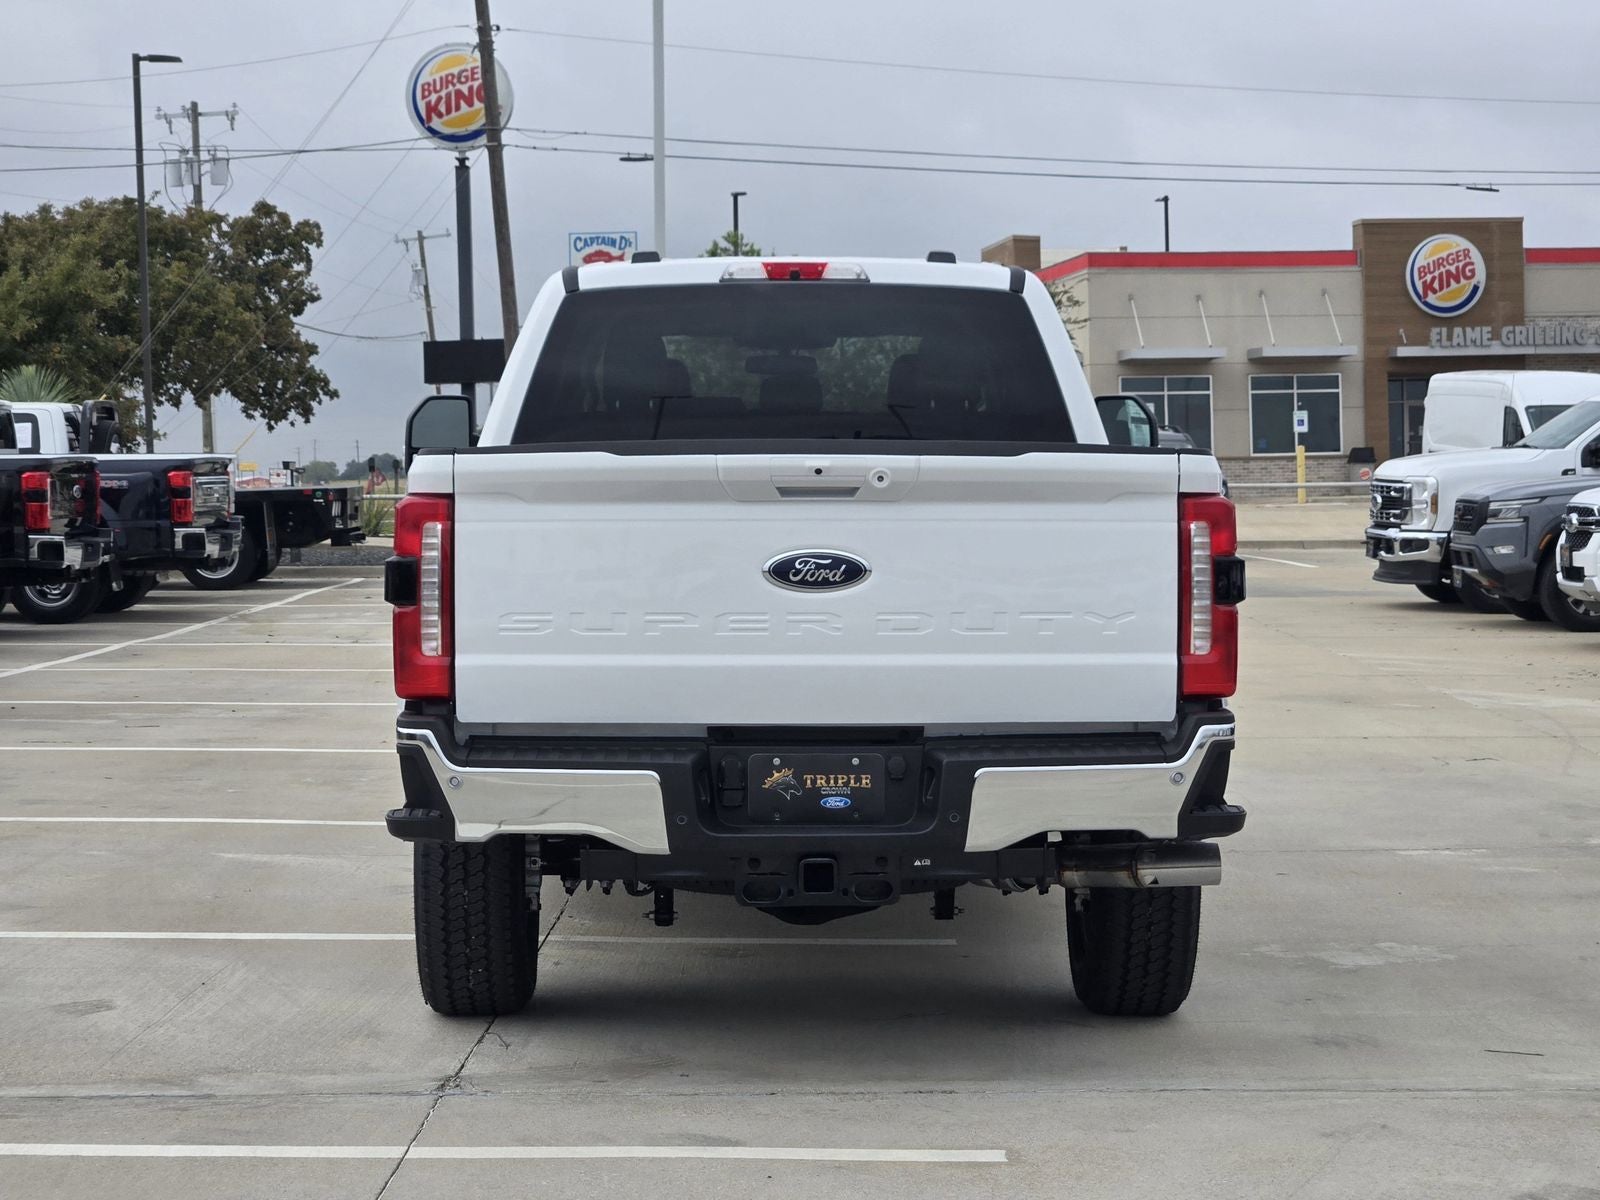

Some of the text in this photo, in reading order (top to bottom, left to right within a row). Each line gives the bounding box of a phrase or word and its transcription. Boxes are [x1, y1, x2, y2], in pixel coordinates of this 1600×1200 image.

[421, 65, 480, 100] BURGE
[1417, 248, 1472, 280] BURGER
[1422, 261, 1476, 300] KING
[1430, 326, 1492, 348] FLAME
[789, 557, 847, 582] Ford
[498, 611, 1137, 636] SUPER DUTY
[803, 774, 872, 788] TRIPLE
